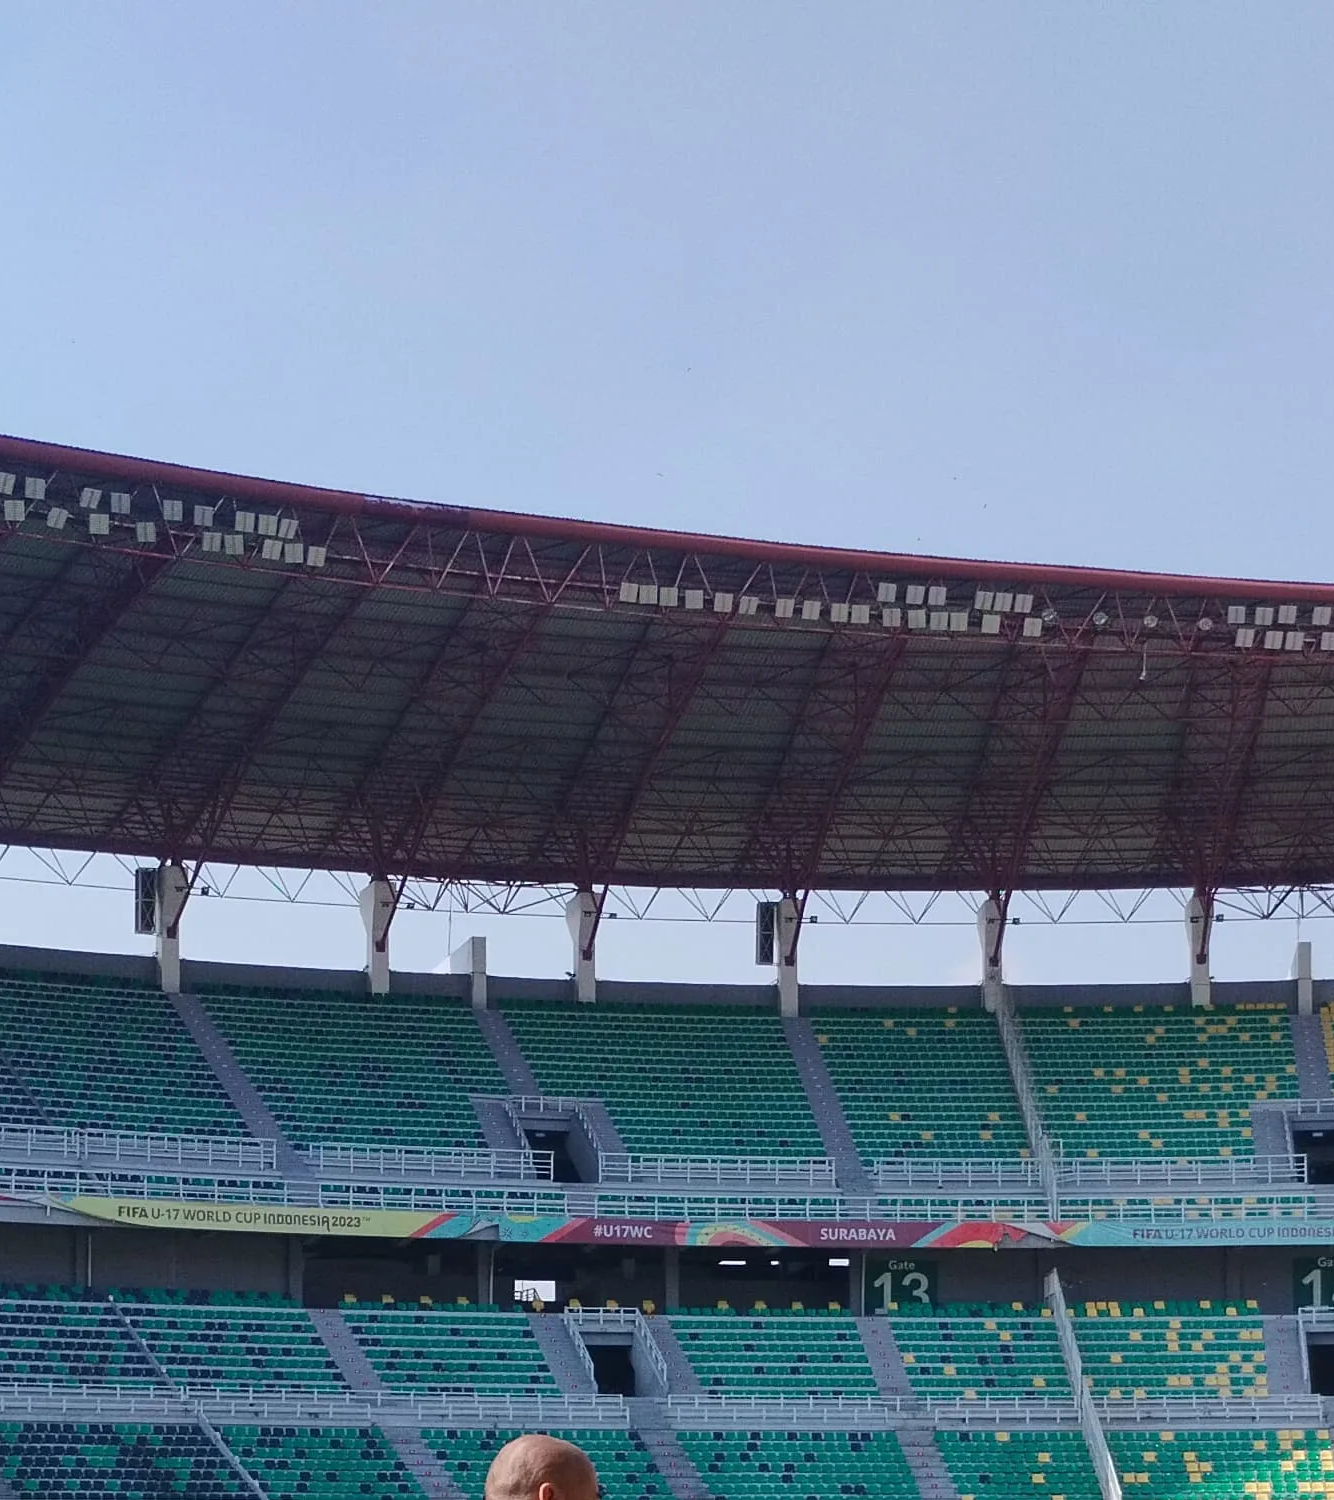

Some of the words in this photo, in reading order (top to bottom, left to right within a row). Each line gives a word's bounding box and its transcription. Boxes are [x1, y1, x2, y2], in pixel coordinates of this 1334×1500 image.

[118, 1206, 148, 1218] FIFA
[151, 1208, 180, 1220] U-17
[182, 1209, 231, 1222] WORLD
[235, 1211, 261, 1224] CUP
[264, 1213, 330, 1232] INDONESIA
[593, 1224, 653, 1238] #U17WC
[820, 1228, 896, 1241] SURABAYA
[1132, 1228, 1163, 1239] FIFA
[1165, 1228, 1193, 1240] U-17
[1195, 1228, 1245, 1239] WORLD
[1248, 1227, 1275, 1238] CUP
[888, 1260, 916, 1270] Gate
[873, 1272, 930, 1314] 13
